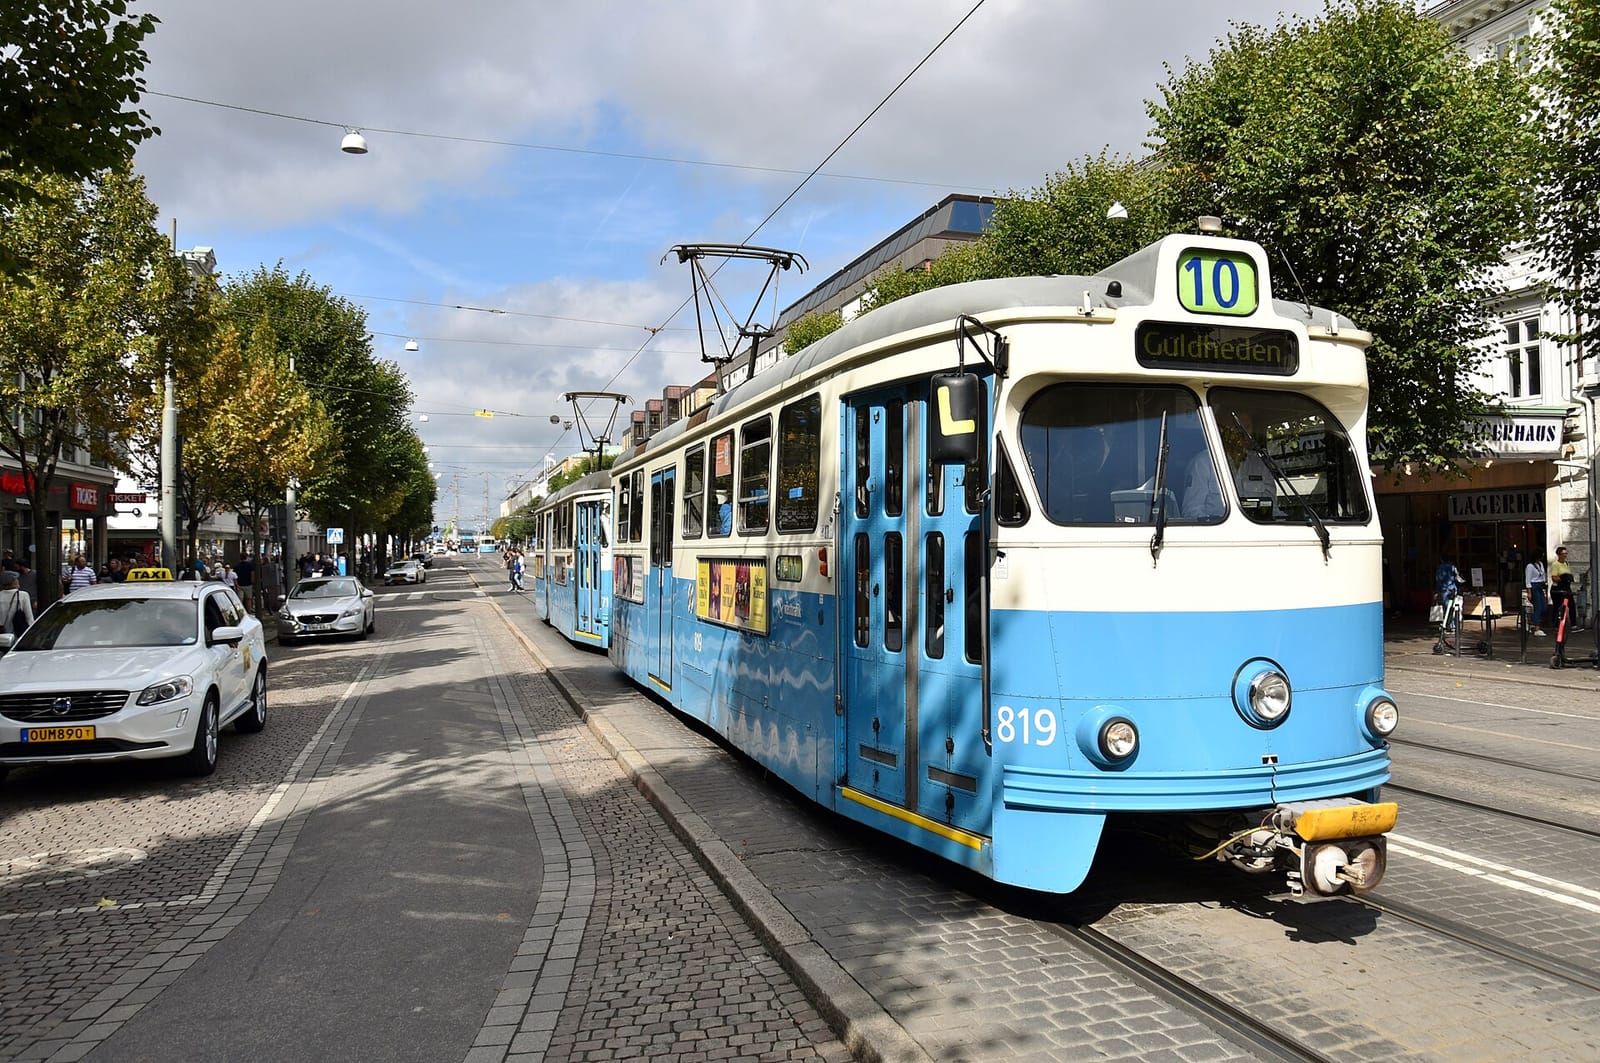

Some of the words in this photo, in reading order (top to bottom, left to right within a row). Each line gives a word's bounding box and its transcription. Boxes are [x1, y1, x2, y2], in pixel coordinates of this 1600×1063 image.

[1184, 257, 1240, 309] 10
[1143, 331, 1281, 363] Guldheden
[1462, 424, 1556, 442] GERHAUS
[132, 570, 167, 579] TAXI
[30, 728, 83, 741] OUM890
[997, 705, 1057, 746] 819
